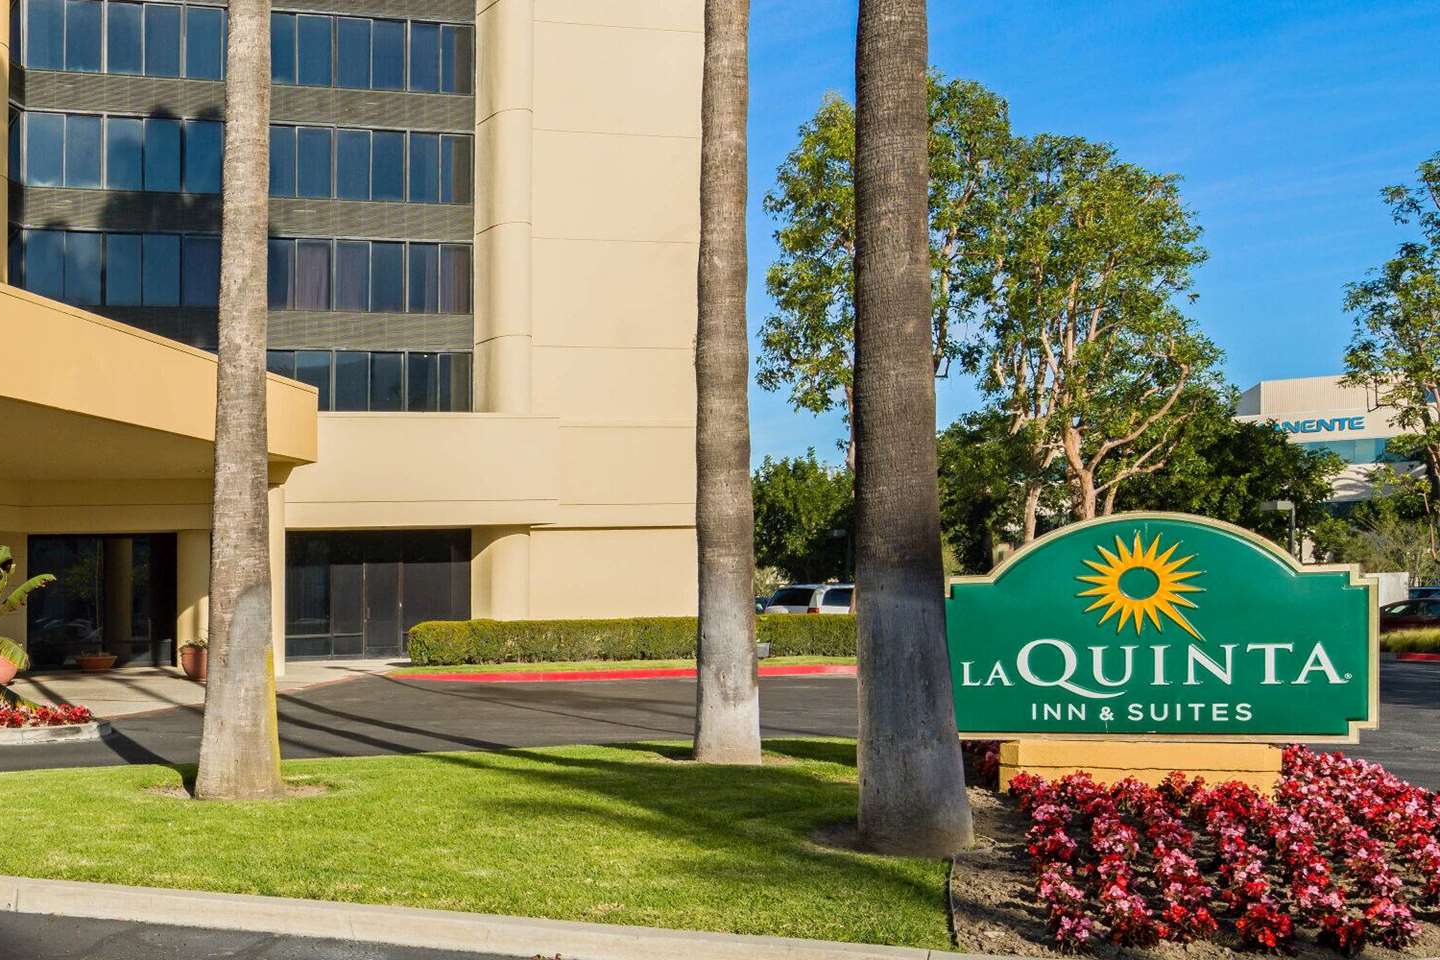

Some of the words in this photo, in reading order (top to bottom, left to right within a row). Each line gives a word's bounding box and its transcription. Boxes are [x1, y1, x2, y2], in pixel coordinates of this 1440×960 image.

[962, 661, 1015, 687] LA
[1015, 638, 1348, 699] QUINTA
[1031, 703, 1087, 722] INN
[1099, 706, 1114, 722] &
[1127, 702, 1254, 722] SUITES
